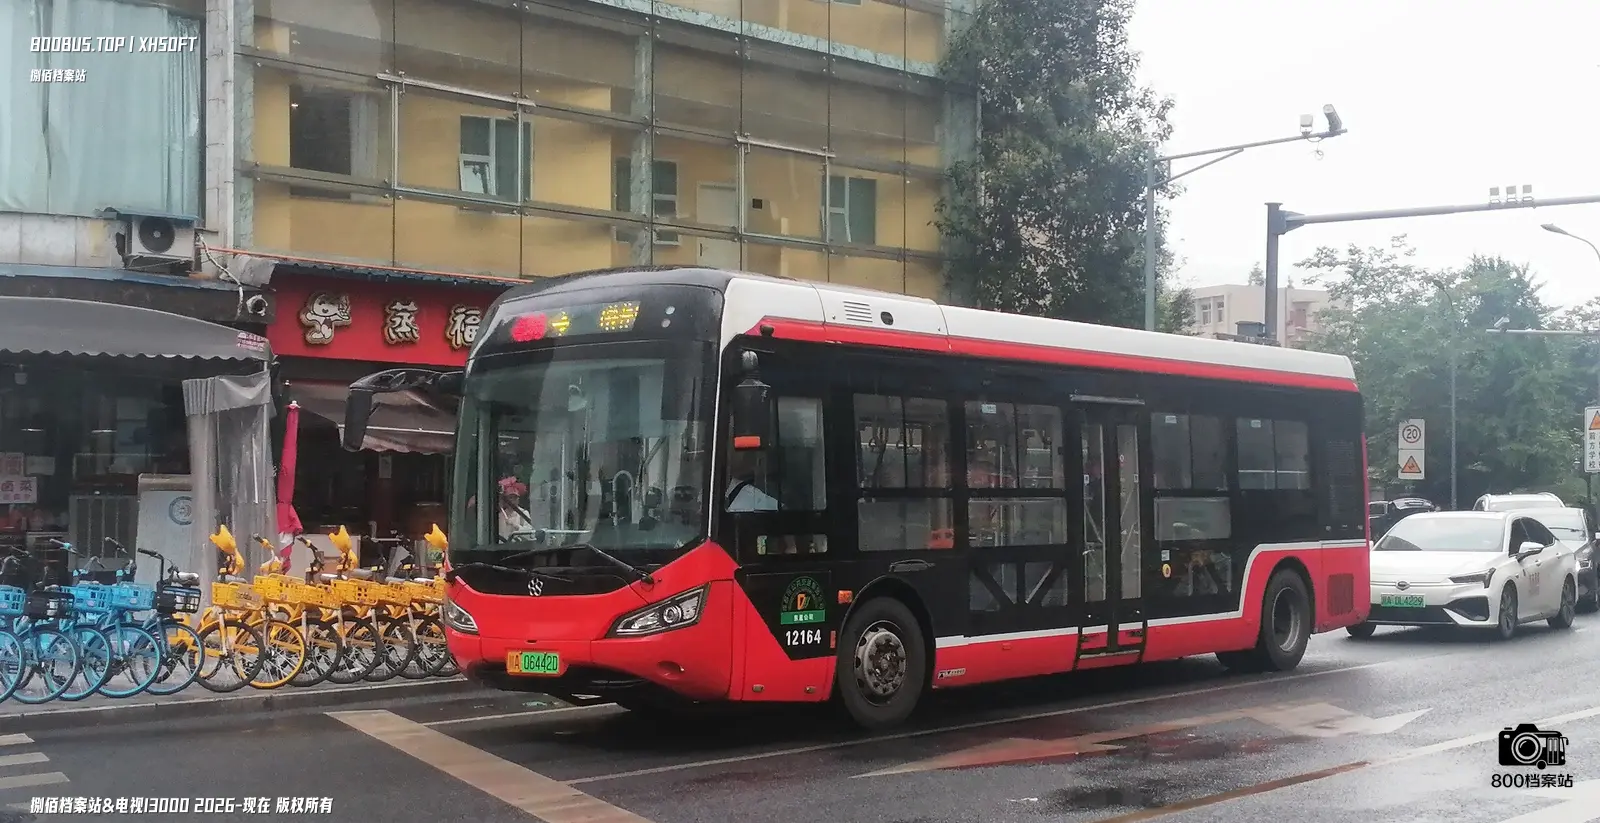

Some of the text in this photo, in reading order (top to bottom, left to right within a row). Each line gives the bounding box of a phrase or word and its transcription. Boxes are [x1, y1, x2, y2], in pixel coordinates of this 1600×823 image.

[1406, 428, 1418, 439] 20
[785, 629, 822, 646] 12164
[523, 654, 558, 671] 06442D
